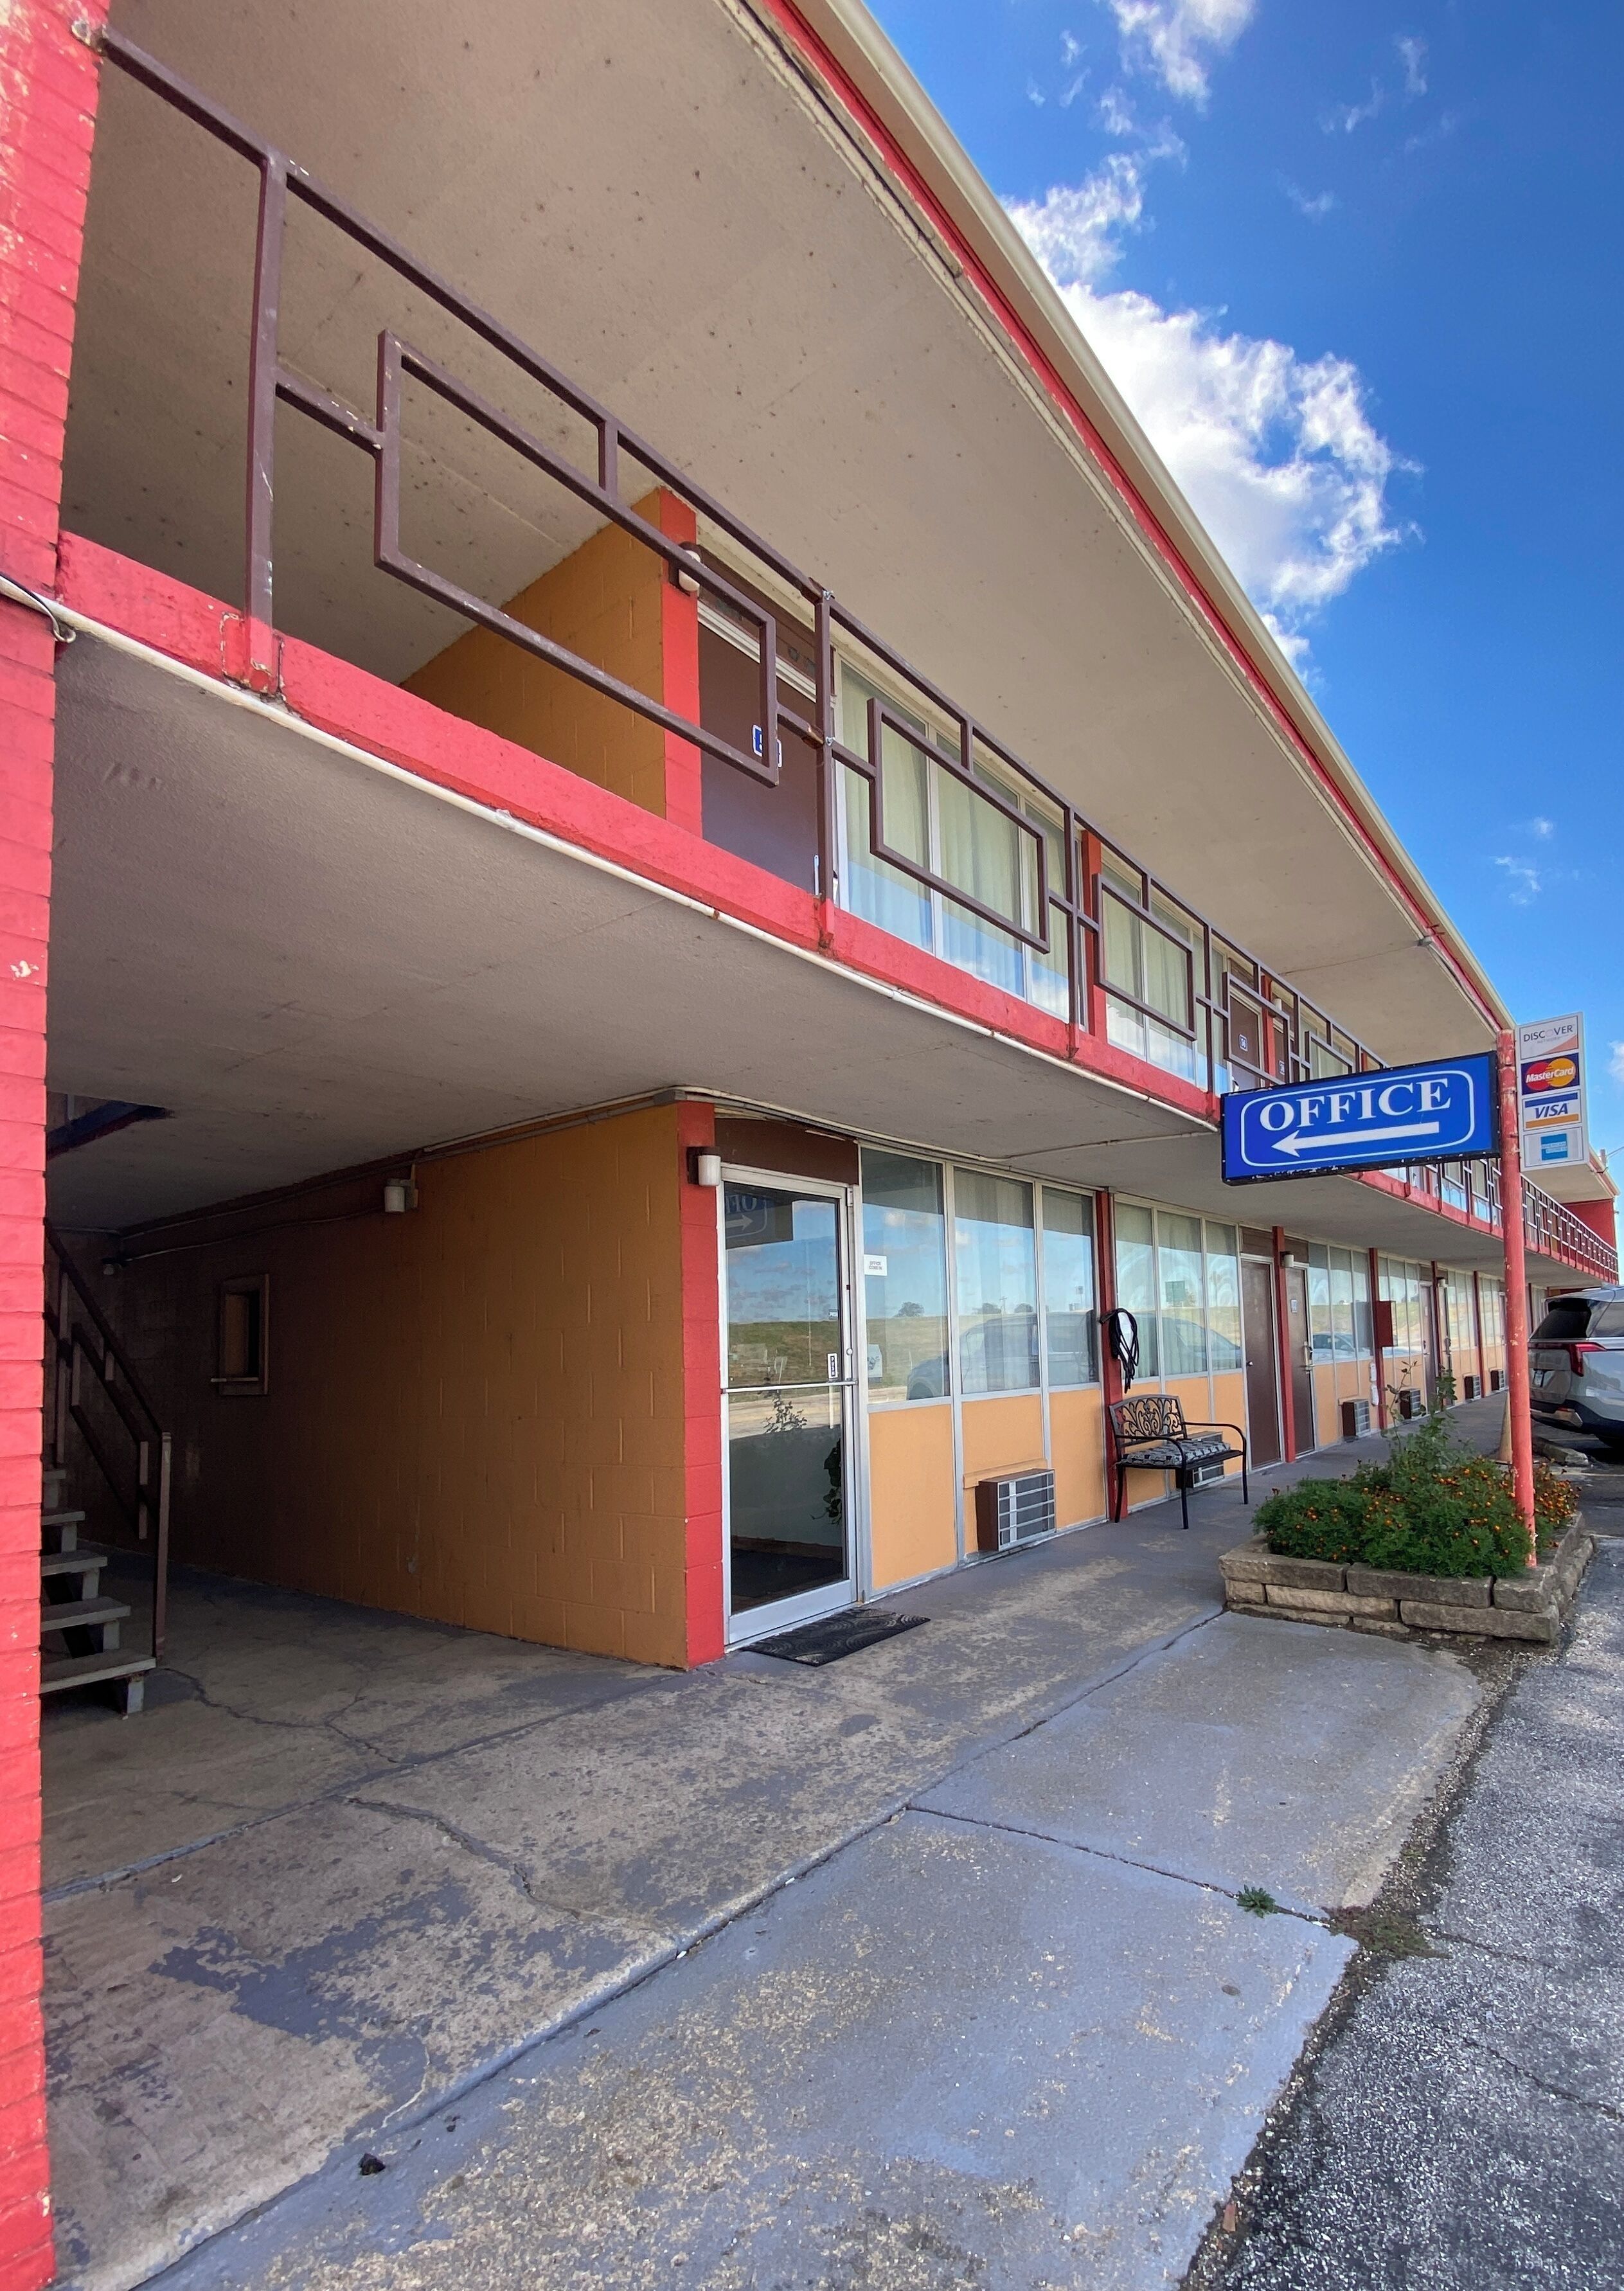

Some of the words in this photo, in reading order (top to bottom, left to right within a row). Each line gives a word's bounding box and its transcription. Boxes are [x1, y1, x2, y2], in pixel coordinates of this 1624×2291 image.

[1526, 1067, 1574, 1083] MasterCard
[1260, 1078, 1451, 1131] OFFICE
[1535, 1103, 1568, 1119] VISA
